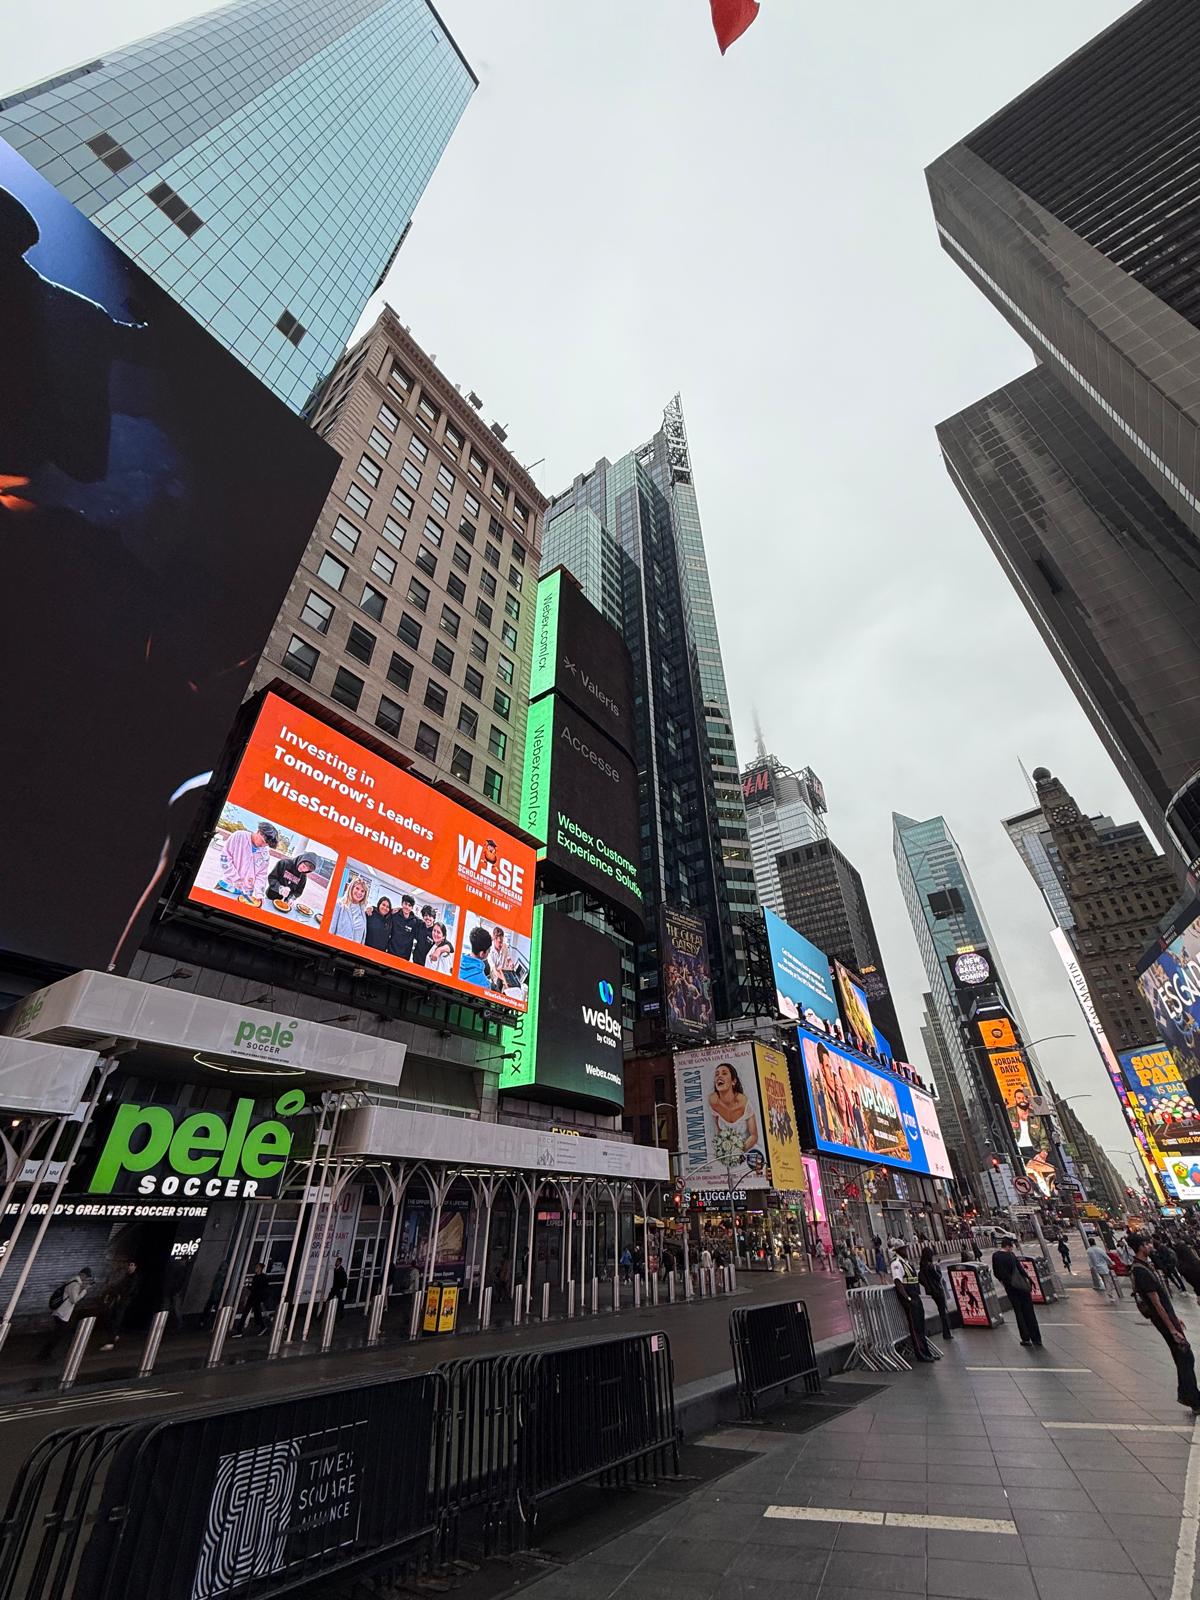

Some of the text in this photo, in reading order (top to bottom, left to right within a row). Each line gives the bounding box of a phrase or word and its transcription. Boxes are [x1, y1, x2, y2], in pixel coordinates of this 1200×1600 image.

[538, 593, 553, 671] Webex.com/cx
[580, 670, 620, 717] Valeris
[280, 726, 375, 788] Investing in
[274, 745, 434, 841] Tomorrow's Leaders
[527, 724, 545, 830] Webex.com/cx
[742, 768, 769, 798] H&M
[264, 772, 431, 870] WiseScholarship.org
[557, 811, 638, 876] Webex Customer
[557, 830, 612, 876] Experience
[458, 834, 524, 895] WISE
[458, 864, 496, 888] SCHOLARSHIP
[497, 884, 523, 902] PROGRAM
[960, 972, 990, 982] COMING
[1066, 961, 1091, 1003] MARTIN
[582, 1006, 622, 1040] webex
[246, 1042, 280, 1054] SOCCER
[994, 1056, 1022, 1066] JORDAN
[1000, 1064, 1020, 1074] DAVIS
[860, 1086, 897, 1118] UPLOAD
[1156, 1086, 1165, 1094] IS
[88, 1088, 306, 1194] pelé
[686, 1106, 707, 1165] MAMMA
[138, 1175, 258, 1198] SOCCER
[699, 1190, 747, 1201] LUGGAGE
[75, 1204, 134, 1216] GREATEST
[134, 1206, 176, 1216] SOCCER
[177, 1206, 208, 1217] STORE
[170, 1238, 202, 1256] pelé
[298, 1474, 356, 1510] SQUARE
